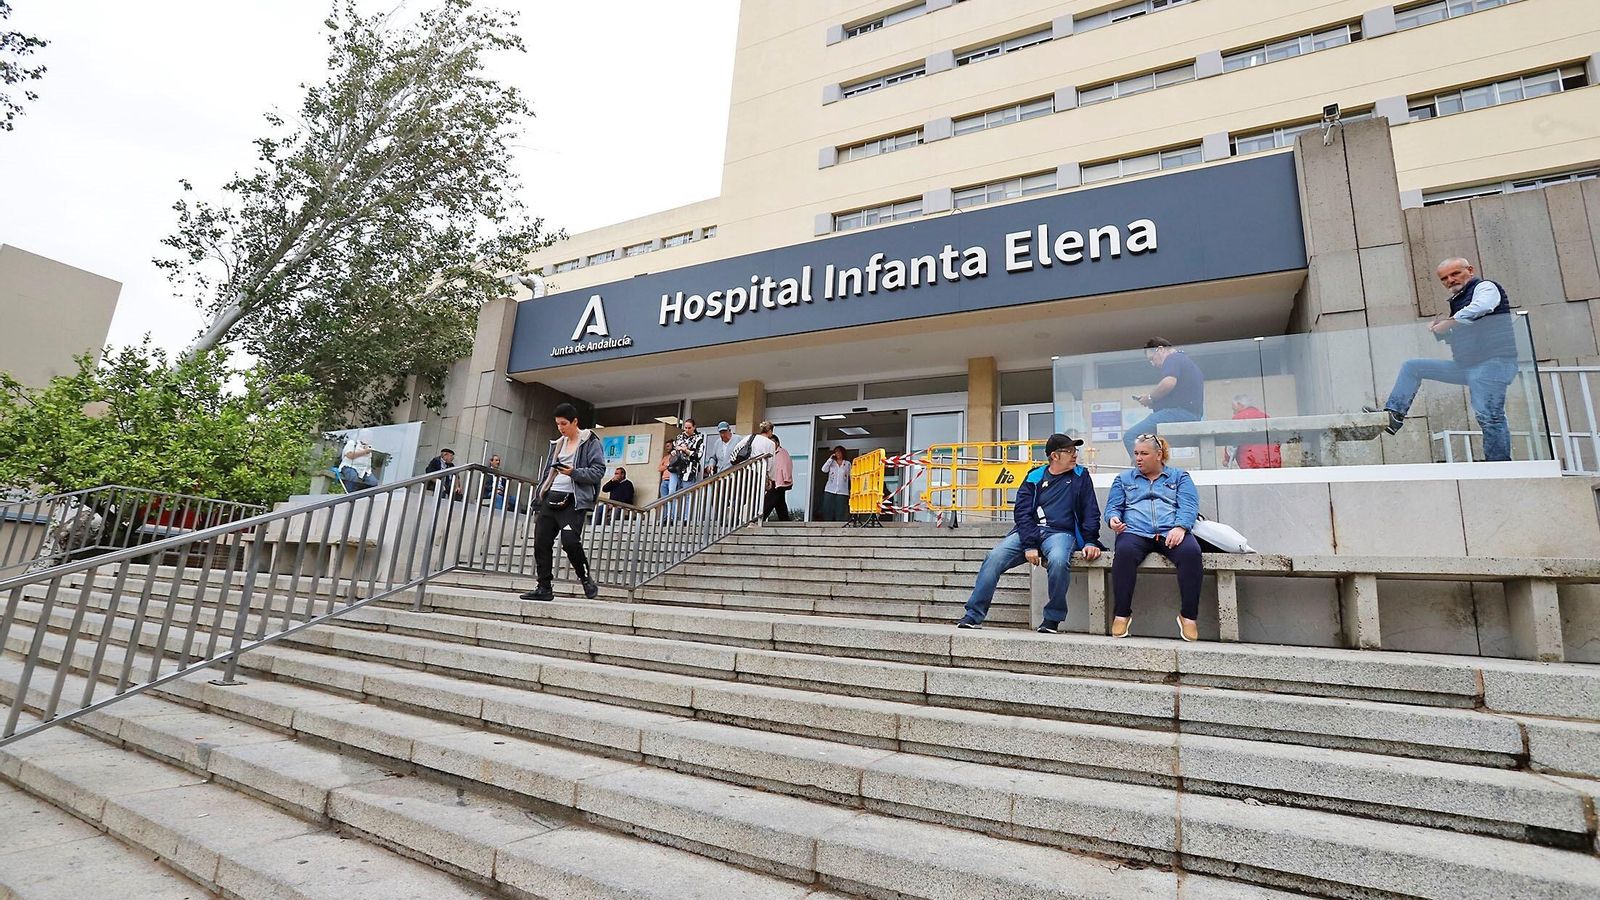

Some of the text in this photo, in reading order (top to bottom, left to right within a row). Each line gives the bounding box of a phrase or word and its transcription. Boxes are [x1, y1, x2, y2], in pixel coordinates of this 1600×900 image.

[659, 217, 1158, 326] Hospital Infanta Elena
[550, 335, 632, 357] Junta de Andalucía
